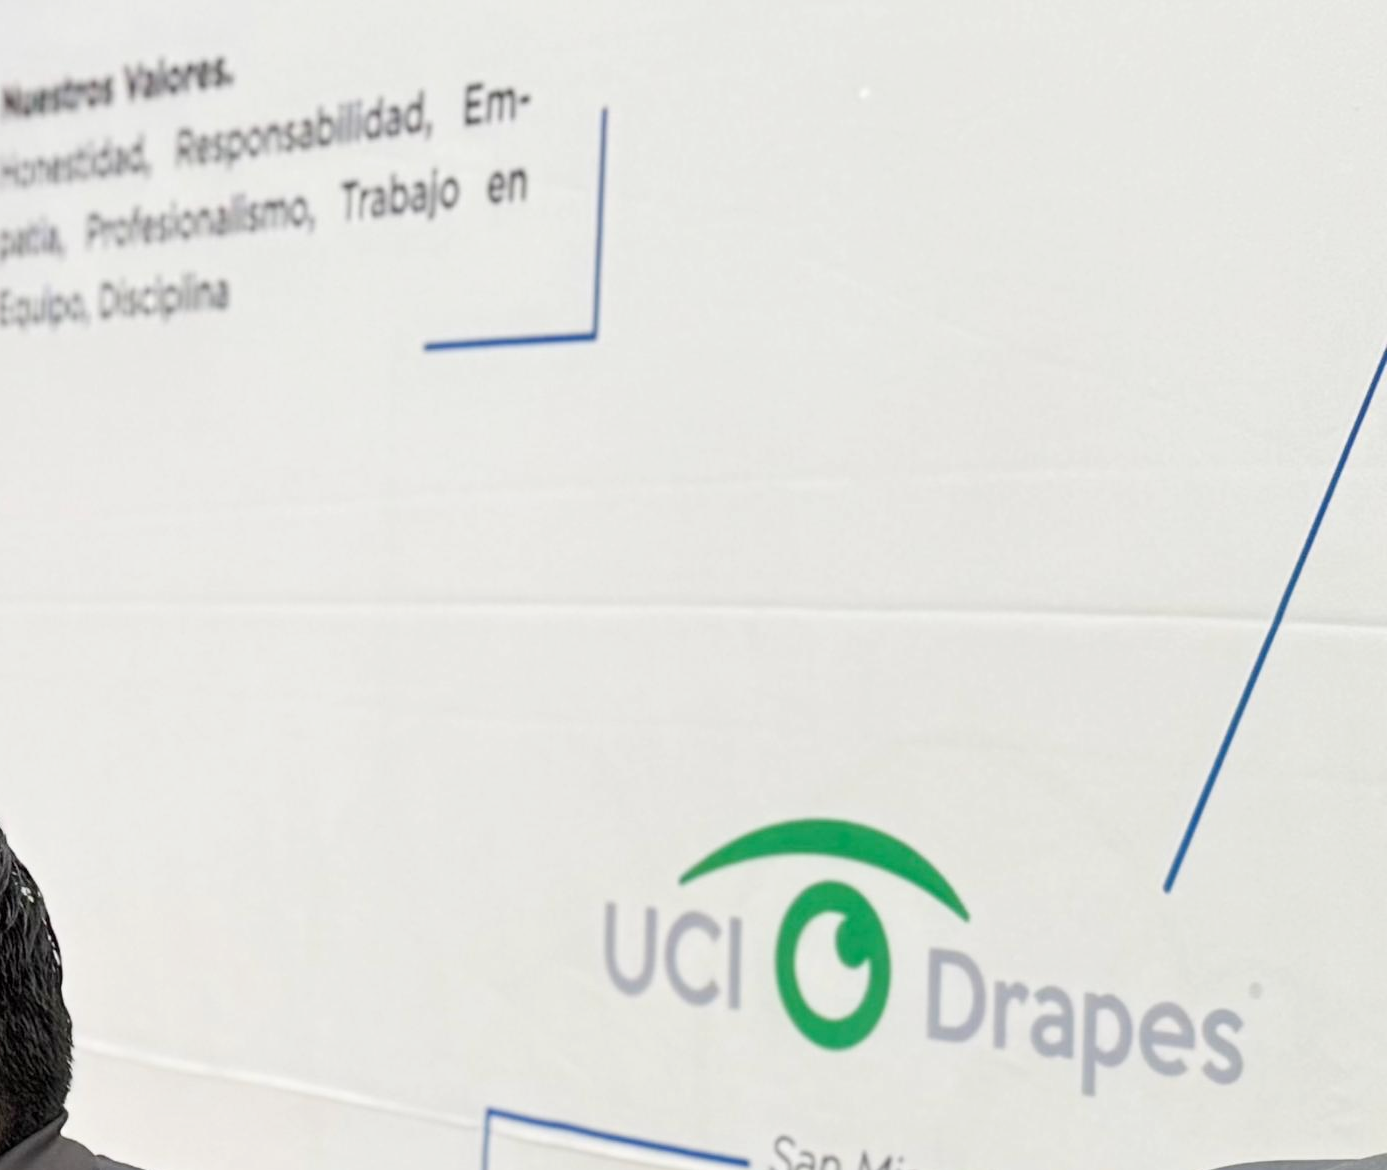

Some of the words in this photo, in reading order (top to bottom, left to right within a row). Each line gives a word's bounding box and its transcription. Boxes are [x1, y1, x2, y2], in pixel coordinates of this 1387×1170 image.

[1, 76, 114, 118] Nuestros
[125, 56, 234, 101] Valores.
[0, 134, 151, 189] Honestidad,
[176, 89, 433, 169] Responsabilidad,
[463, 83, 531, 129] Em-
[86, 194, 317, 248] Profesionalismo,
[341, 169, 460, 223] Trabajo
[487, 167, 527, 205] en
[100, 272, 230, 323] Disciplina
[604, 901, 743, 1011] UCI
[926, 947, 1245, 1097] Drapes
